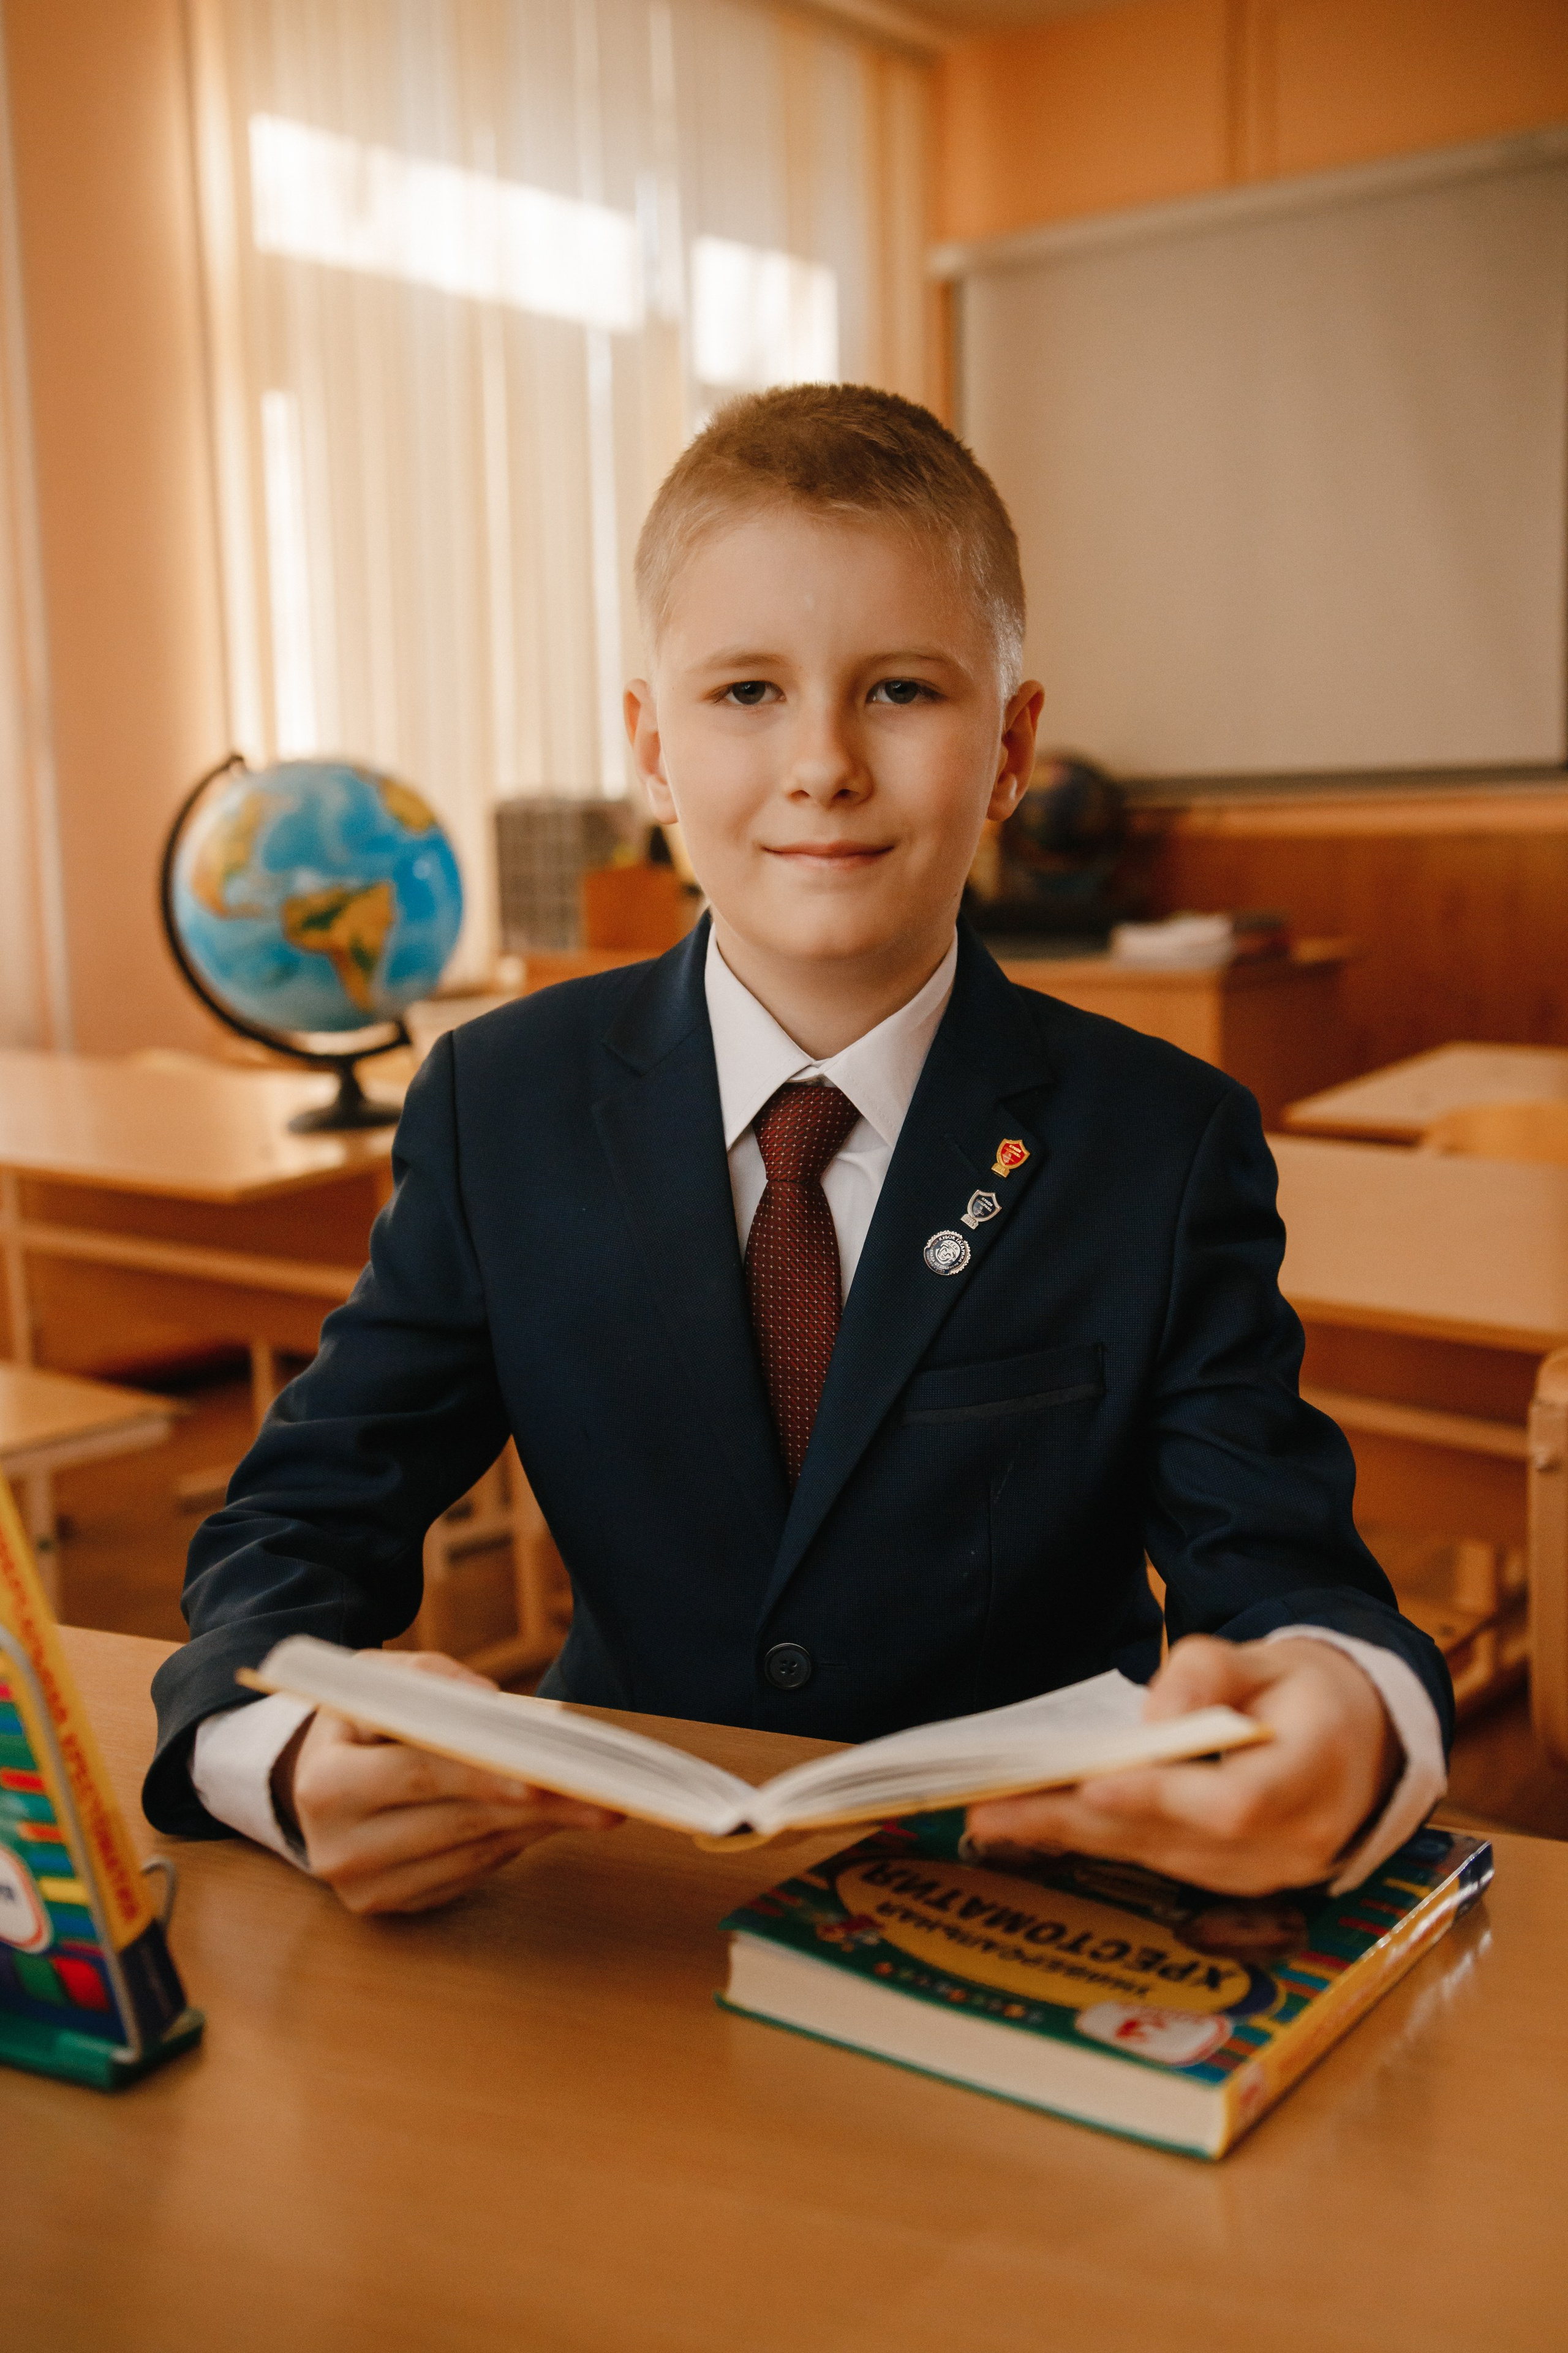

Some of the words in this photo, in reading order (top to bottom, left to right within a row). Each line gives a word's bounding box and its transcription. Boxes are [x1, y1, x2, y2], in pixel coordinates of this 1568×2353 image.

[948, 1241, 958, 1250] СССР
[956, 1238, 965, 1263] ГАГАРИНА
[861, 1862, 1240, 1992] ХРЕСТОМАТИЯ
